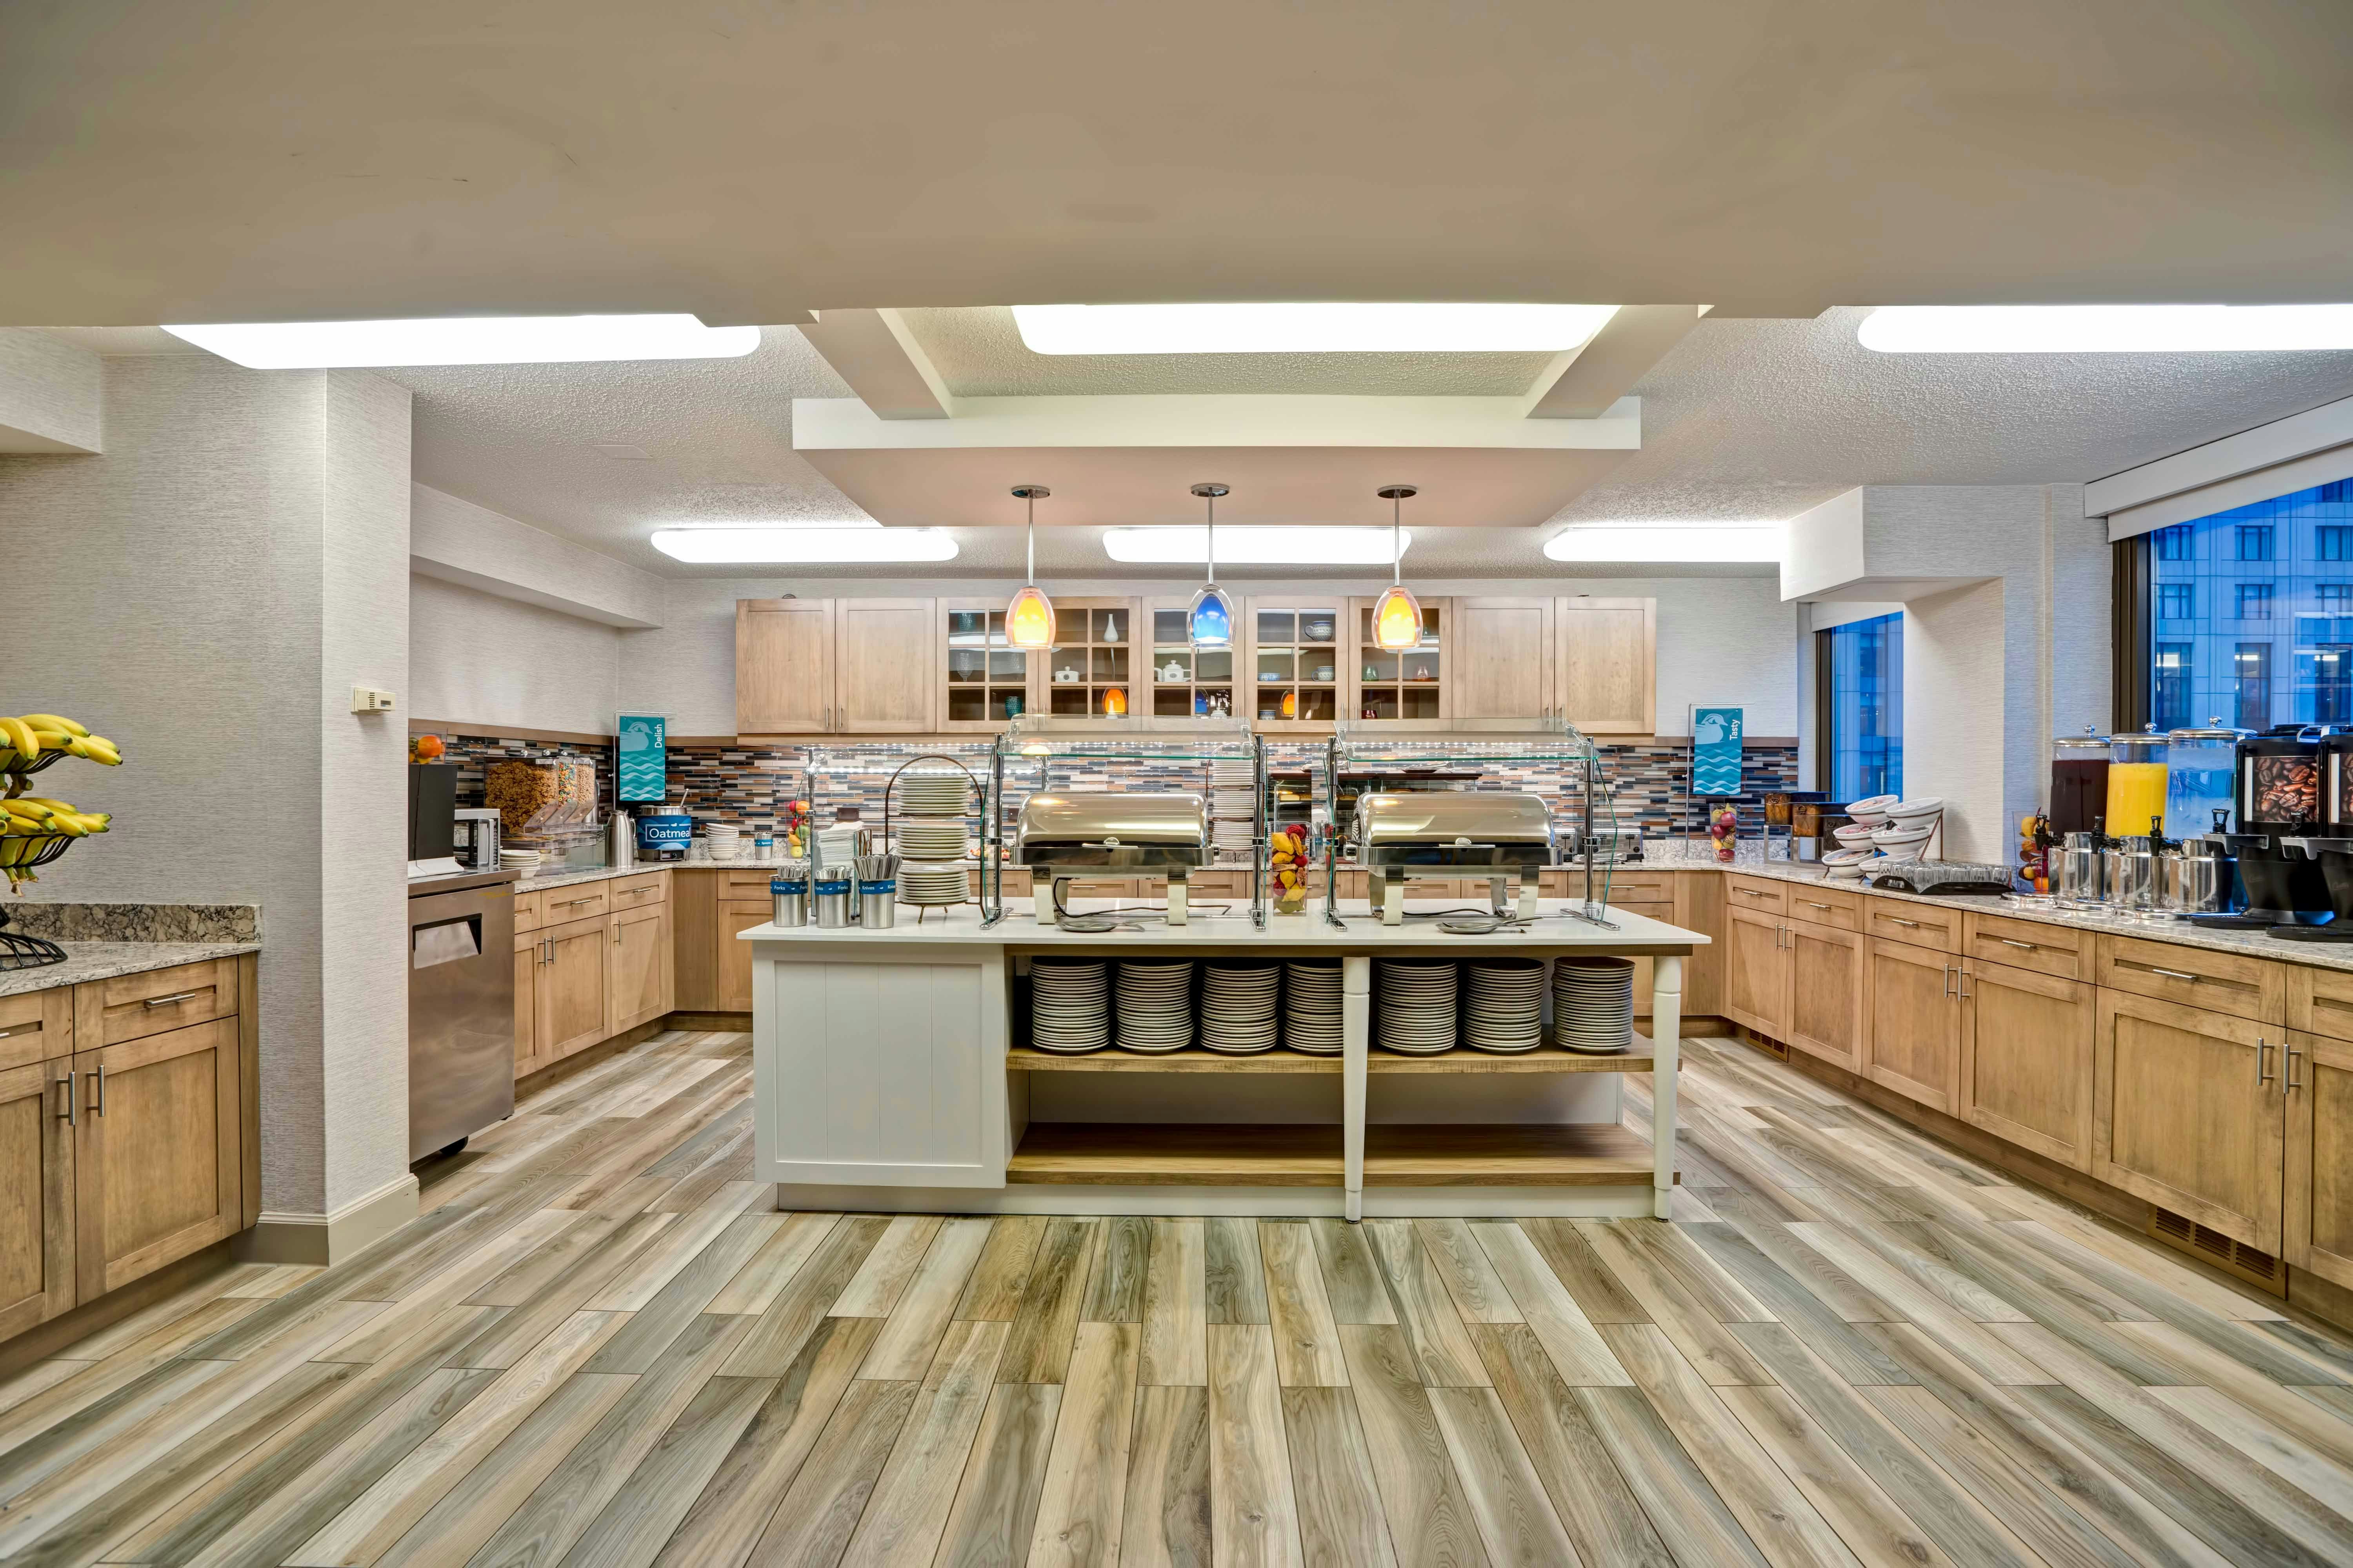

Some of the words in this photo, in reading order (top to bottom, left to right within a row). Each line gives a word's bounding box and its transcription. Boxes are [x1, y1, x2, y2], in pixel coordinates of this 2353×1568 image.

[654, 724, 662, 748] Delish
[1729, 719, 1740, 741] Tasty
[649, 827, 690, 838] Oatmeal
